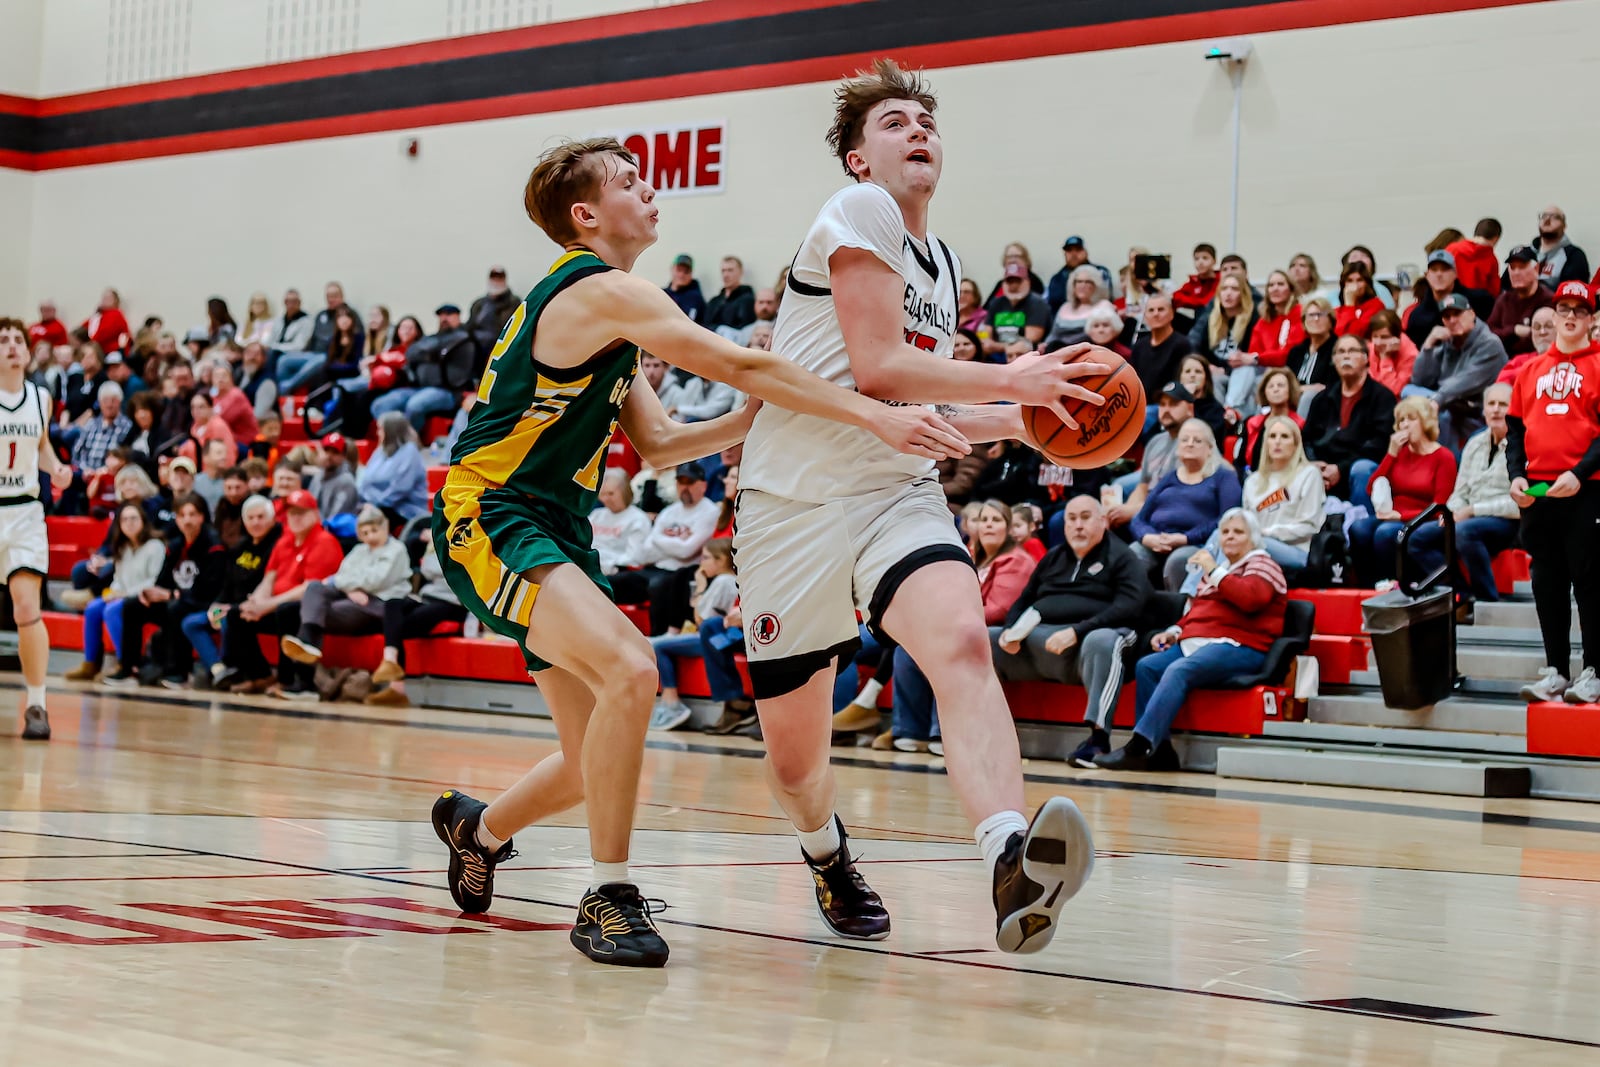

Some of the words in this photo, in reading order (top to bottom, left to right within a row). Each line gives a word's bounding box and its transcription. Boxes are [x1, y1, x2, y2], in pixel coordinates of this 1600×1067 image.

[623, 127, 722, 190] OME
[1076, 382, 1131, 447] Rawlings
[8, 442, 17, 470] 1
